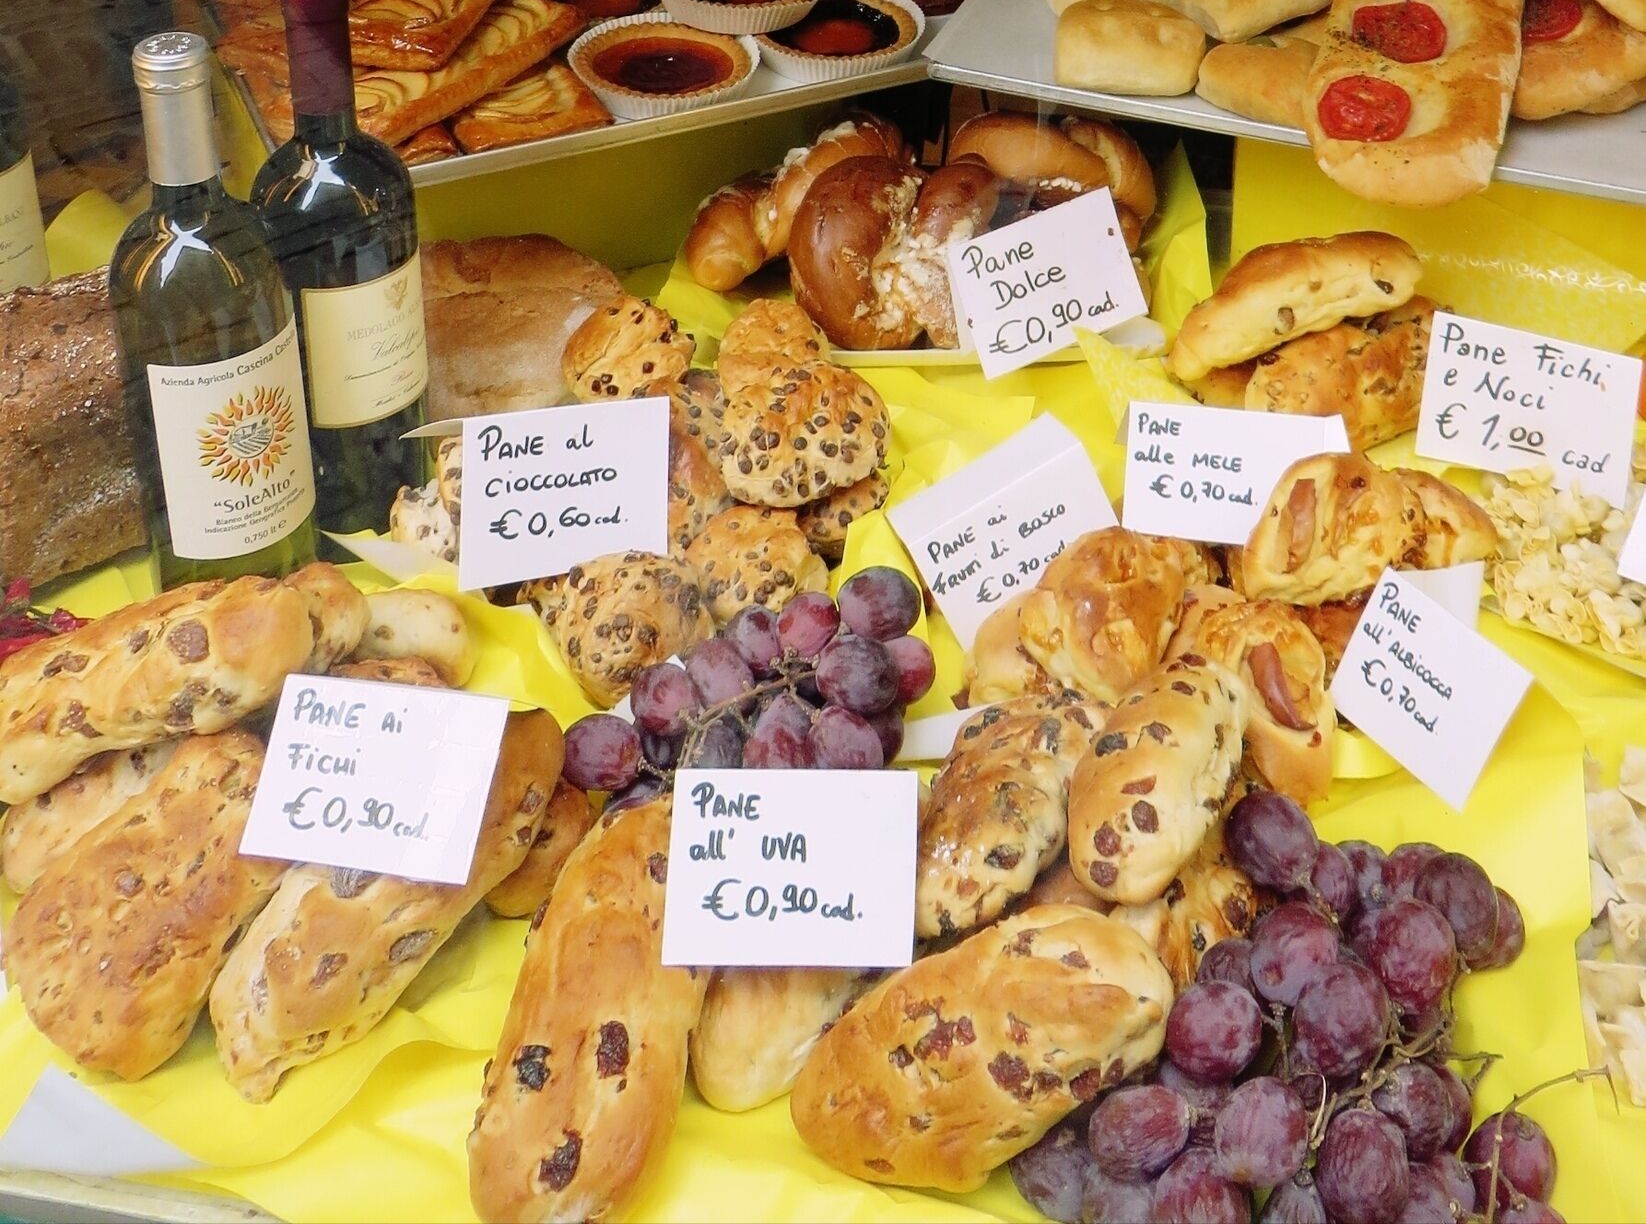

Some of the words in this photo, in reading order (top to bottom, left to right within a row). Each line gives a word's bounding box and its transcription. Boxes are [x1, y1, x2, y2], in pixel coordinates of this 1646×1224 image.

[961, 241, 1034, 279] Pane
[990, 266, 1066, 310] Dolce
[160, 377, 195, 386] Azienda
[197, 371, 235, 386] Agricola
[236, 353, 274, 376] Cascina
[1439, 322, 1507, 365] Pane
[1533, 343, 1611, 385] Fichi
[1443, 367, 1458, 386] e
[1473, 371, 1554, 410] Noci
[478, 424, 545, 461] PANE
[566, 423, 594, 451] al
[1138, 412, 1182, 436] PANE
[1134, 444, 1175, 464] alle
[1191, 453, 1243, 473] MELE
[1562, 449, 1611, 473] cad
[244, 529, 268, 544] 0,750
[927, 526, 976, 564] PANE
[987, 505, 1008, 526] ai
[991, 538, 1010, 560] di
[1018, 504, 1066, 539] BOSCO
[1379, 582, 1422, 634] PANE
[293, 688, 366, 728] PANE
[691, 781, 761, 821] PANE
[689, 828, 735, 862] all'
[761, 832, 807, 863] UVA
